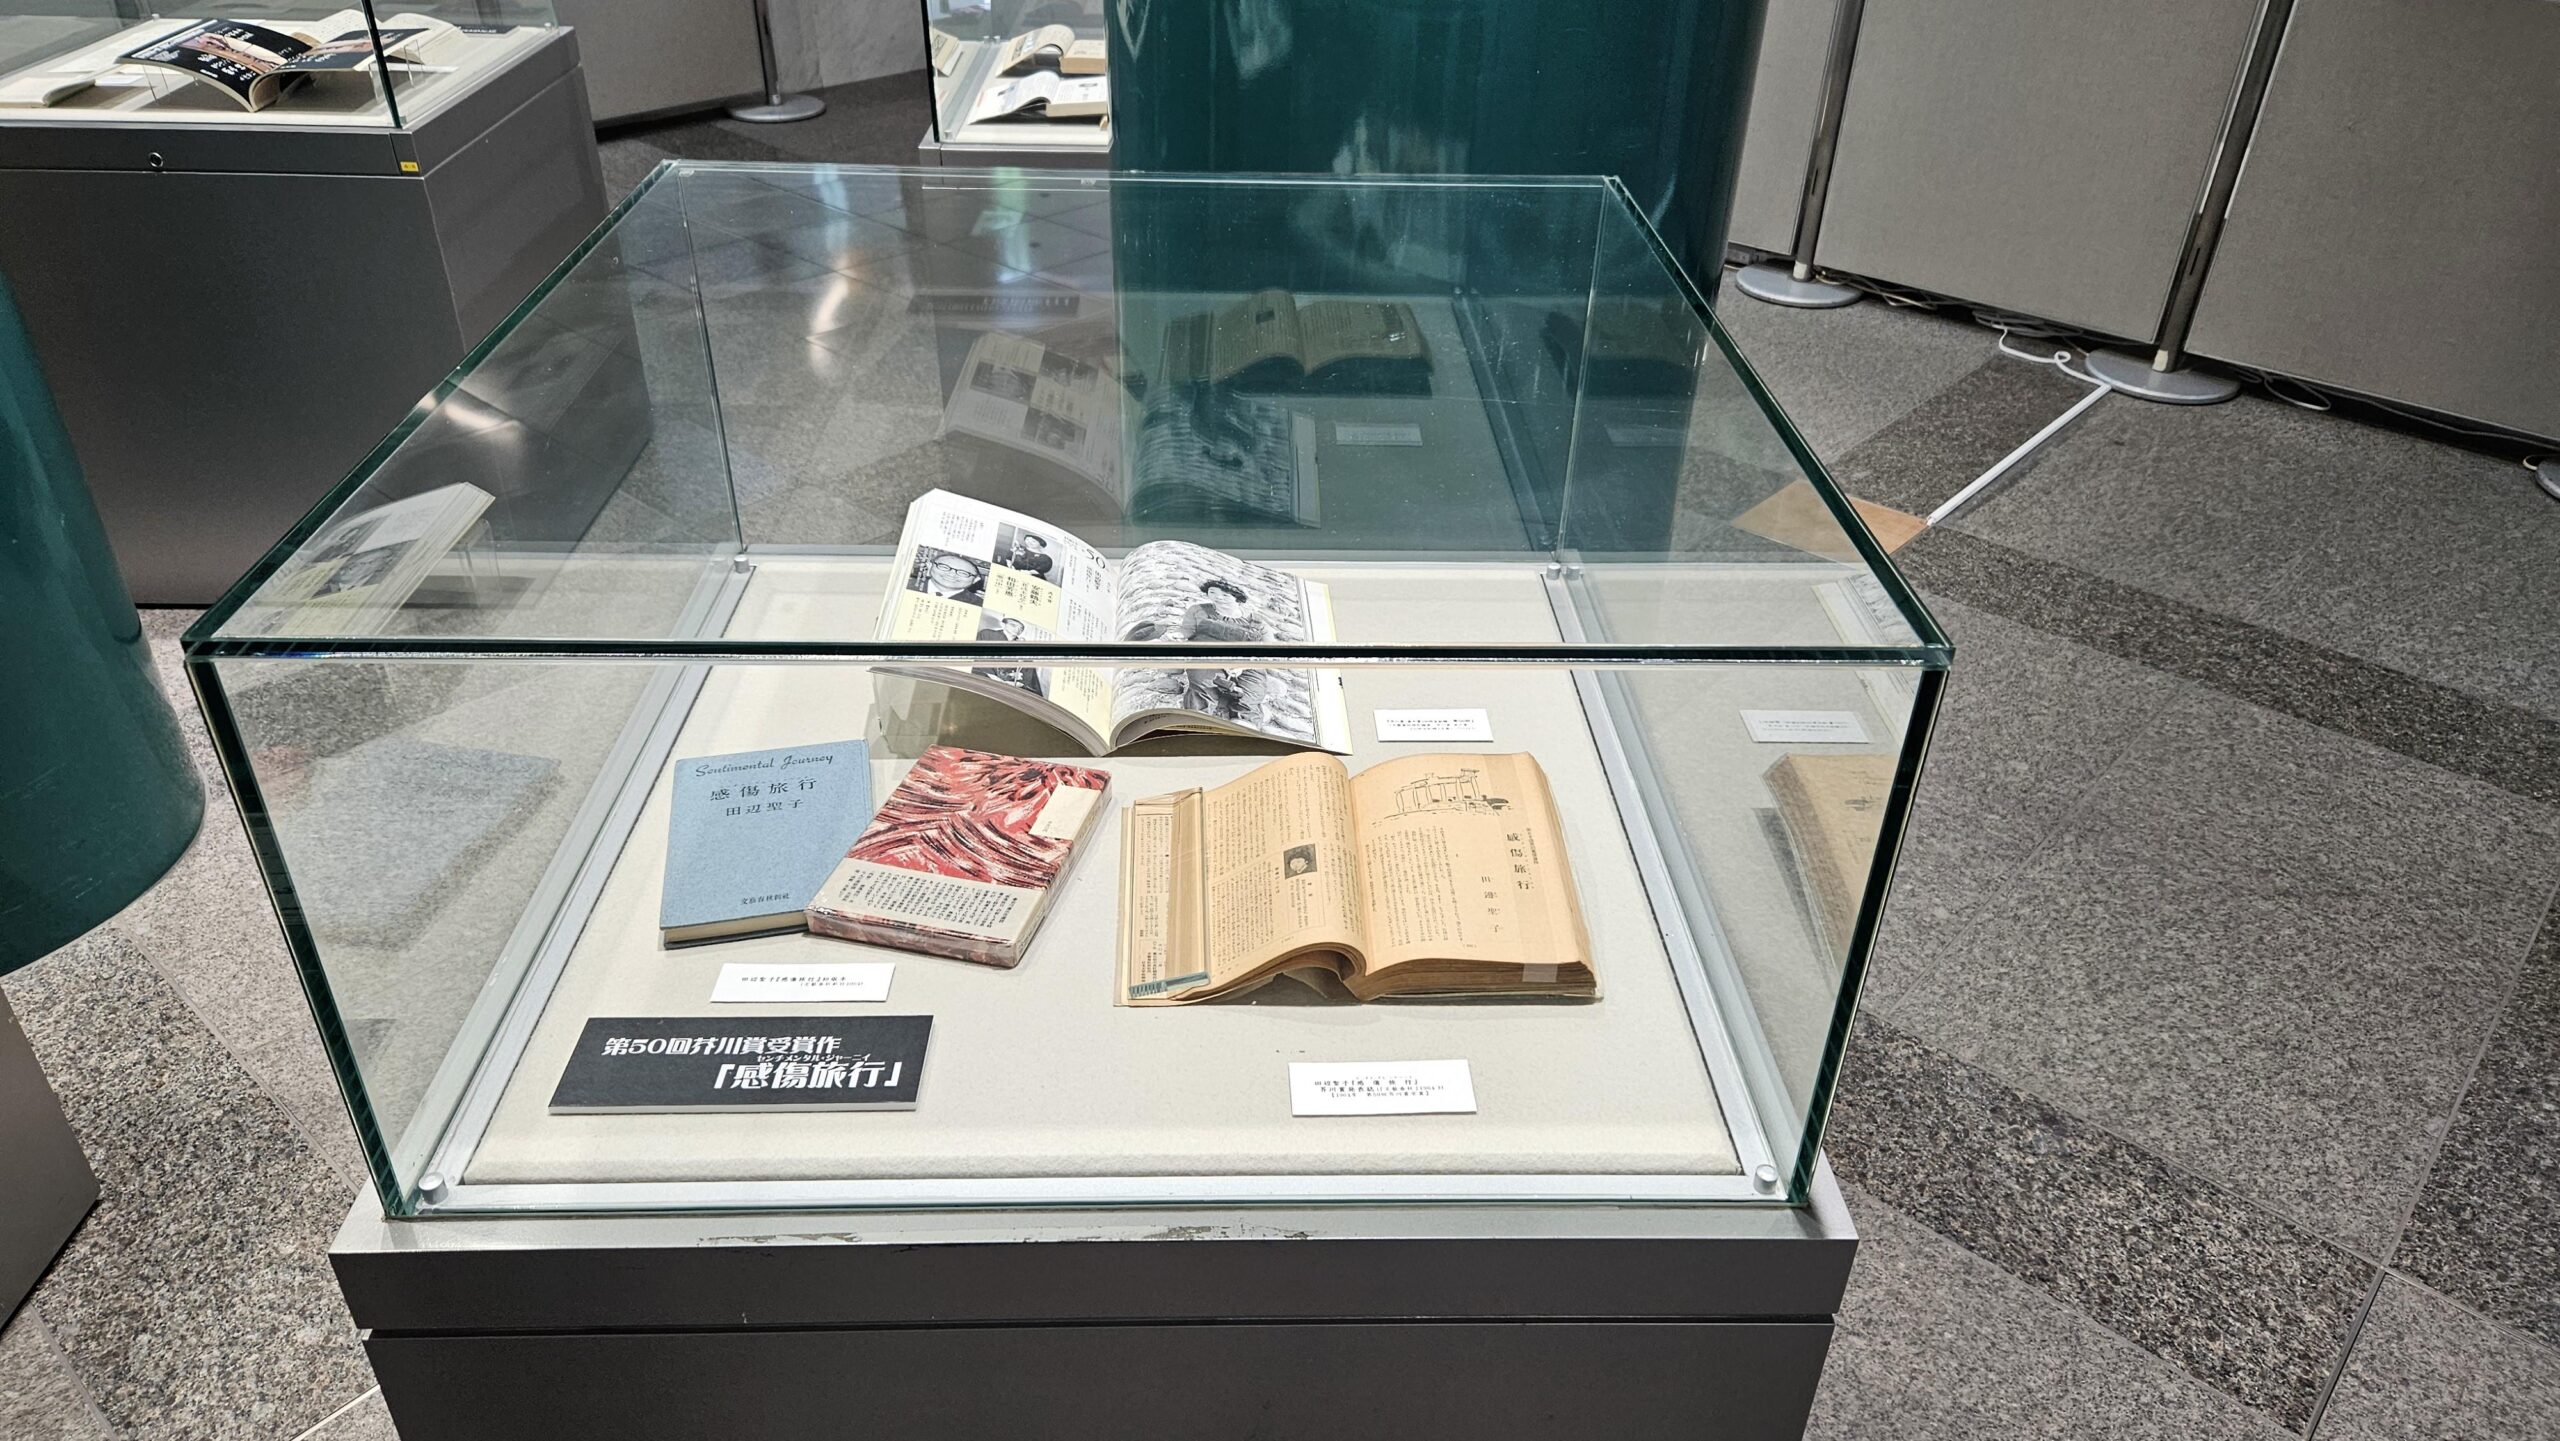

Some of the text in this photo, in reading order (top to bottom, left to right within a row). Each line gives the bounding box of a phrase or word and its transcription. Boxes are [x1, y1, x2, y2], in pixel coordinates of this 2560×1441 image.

[695, 754, 834, 778] Sentimental Journey
[601, 1036, 842, 1056] 第50回芥川賞受賞作
[713, 1060, 903, 1089] 「感傷旅行」
